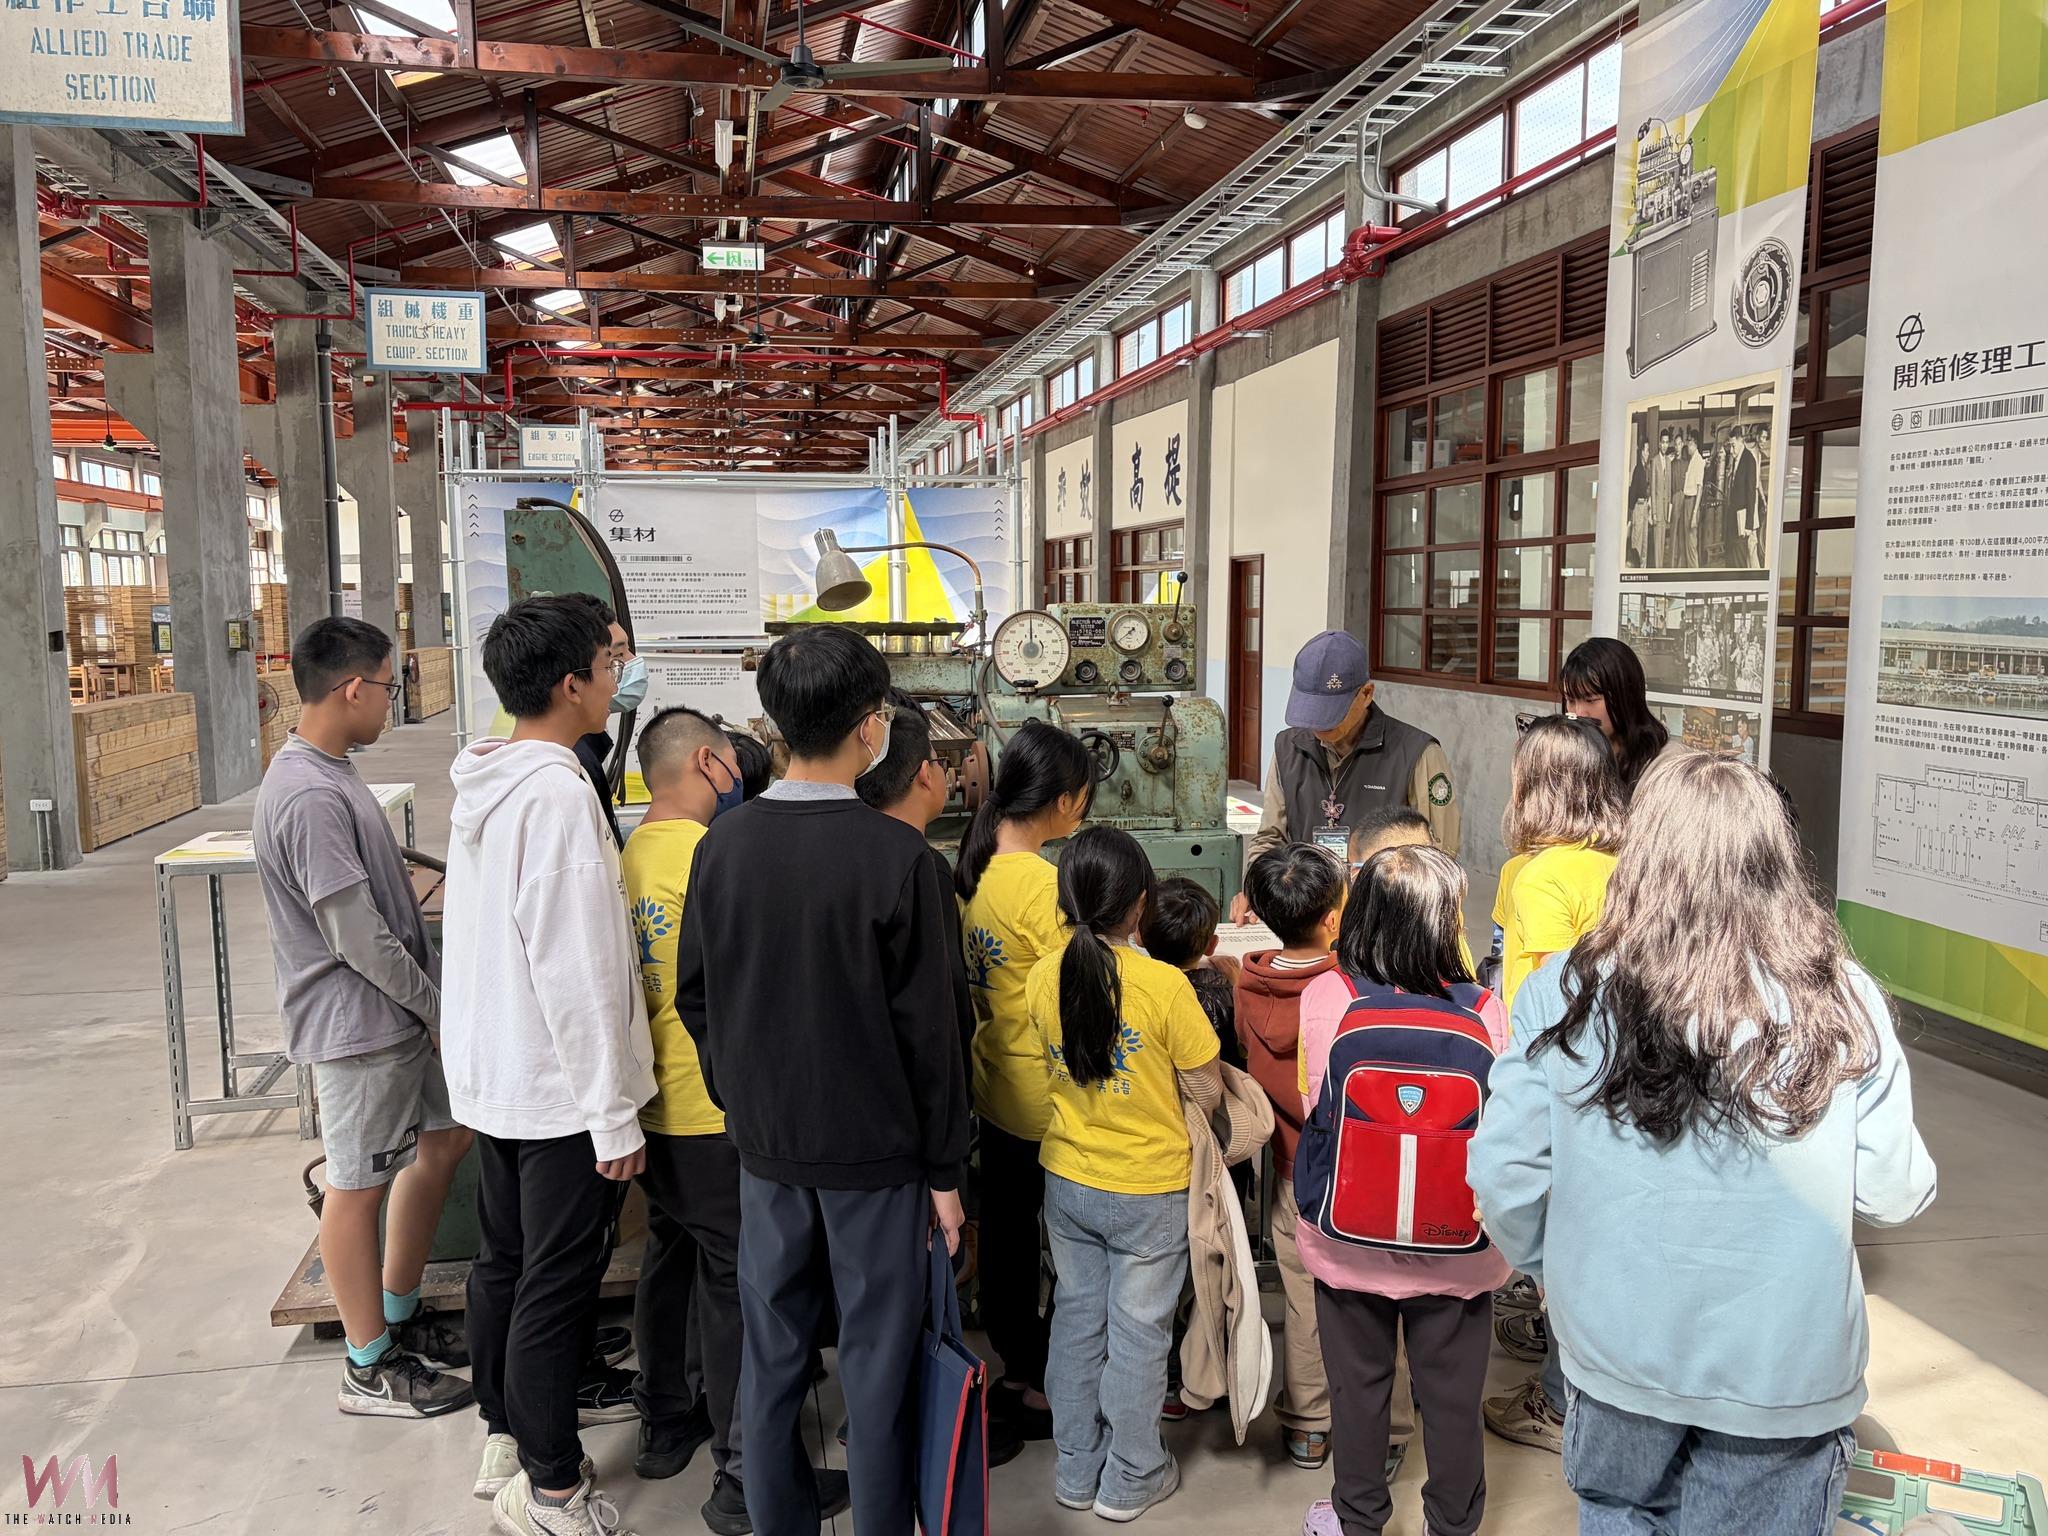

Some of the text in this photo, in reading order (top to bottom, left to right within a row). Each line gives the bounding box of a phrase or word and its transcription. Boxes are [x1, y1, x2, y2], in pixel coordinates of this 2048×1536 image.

[31, 27, 193, 62] ALLIED TRADE
[65, 73, 157, 103] SECTION
[386, 325, 418, 338] TRUCK
[432, 326, 466, 340] HEAVY
[425, 347, 468, 361] SECTION
[1893, 340, 2047, 391] 開箱修理工
[608, 527, 657, 542] 集材
